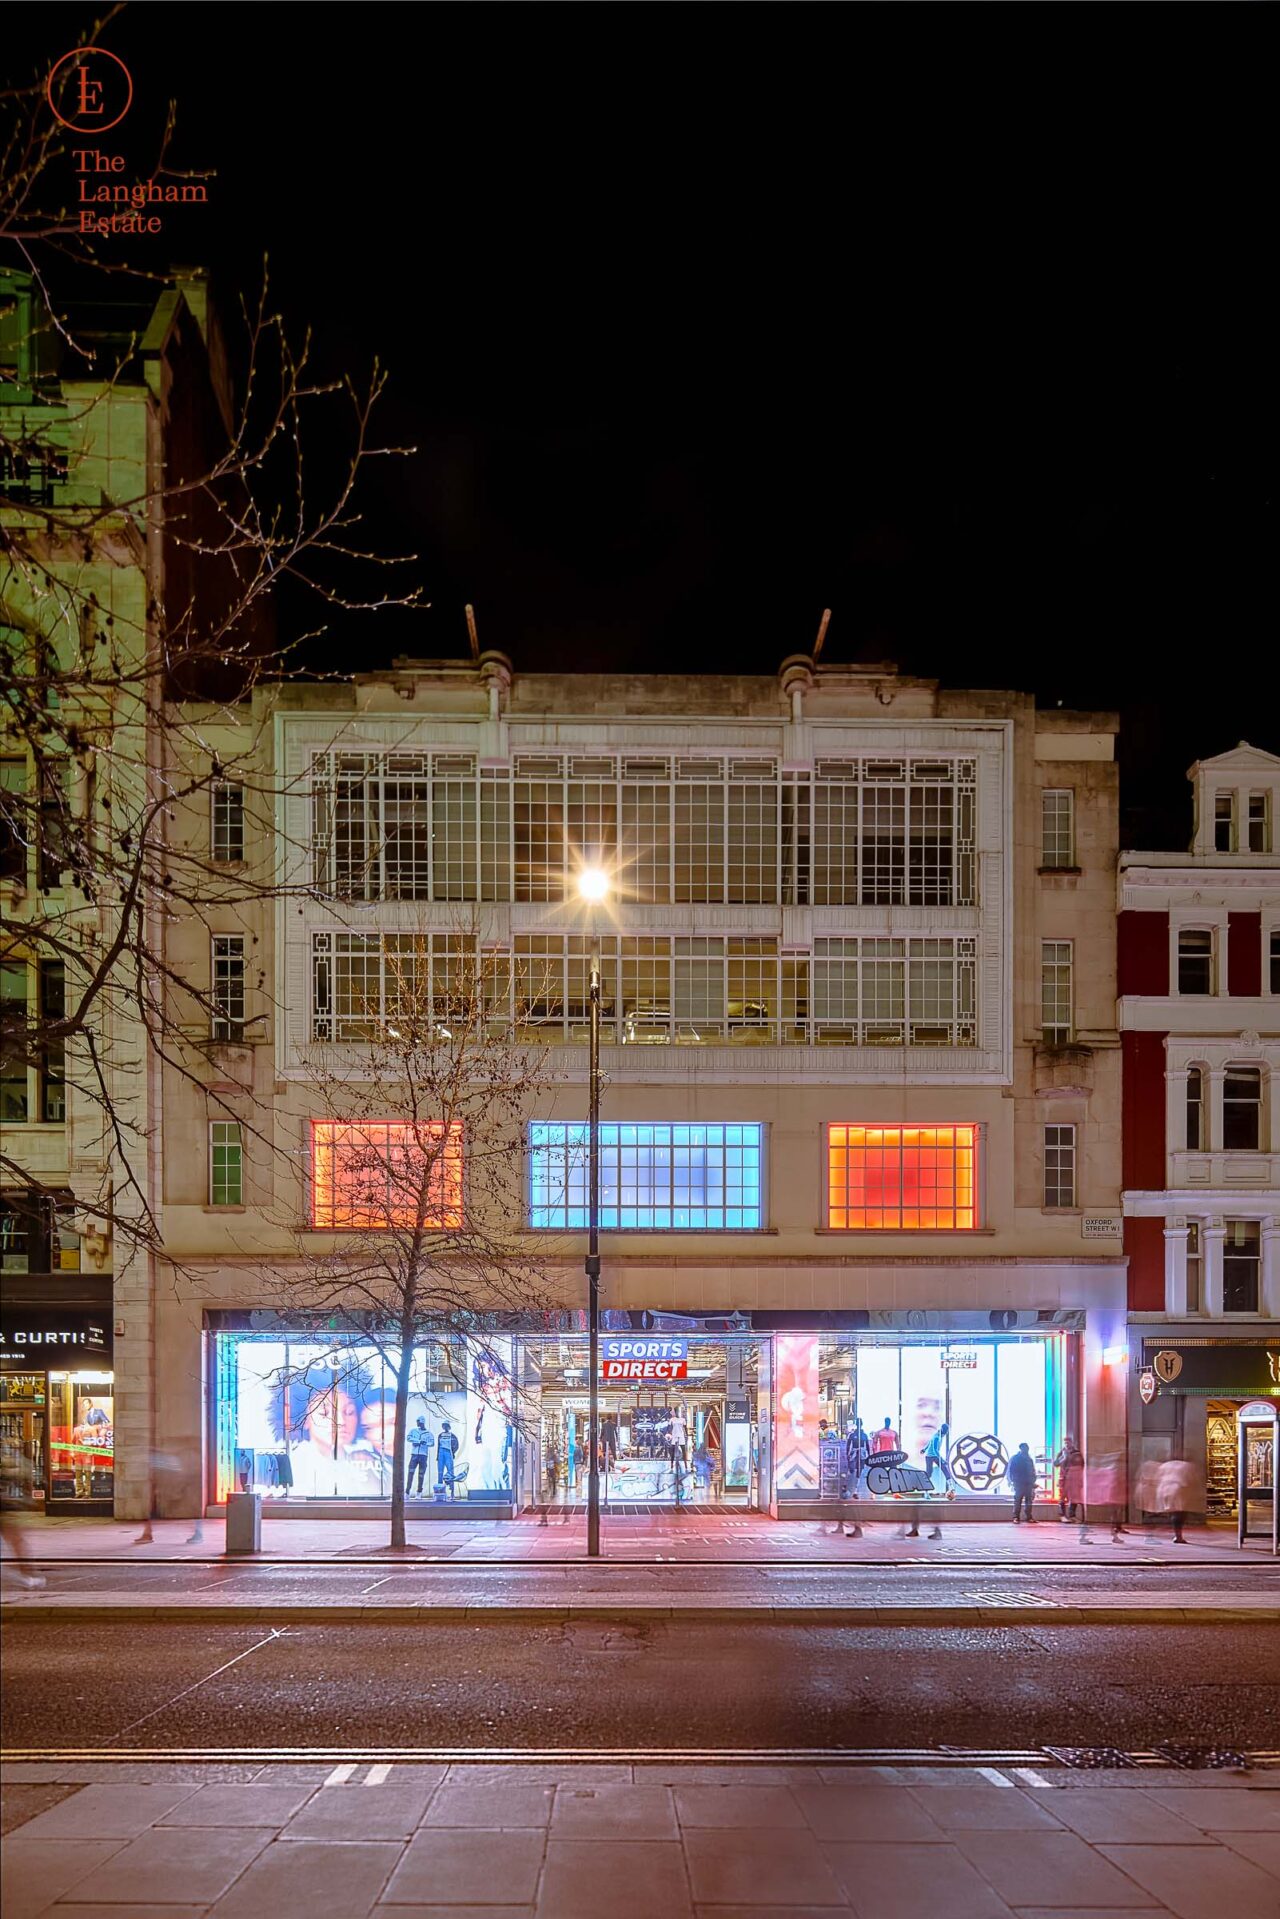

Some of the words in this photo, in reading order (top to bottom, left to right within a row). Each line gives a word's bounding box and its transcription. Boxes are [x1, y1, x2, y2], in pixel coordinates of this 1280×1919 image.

[607, 1342, 683, 1358] SPORTS
[943, 1352, 975, 1360] SPORTS
[607, 1362, 683, 1377] DIRECT
[868, 1455, 894, 1464] MATCH
[893, 1453, 905, 1462] MY
[867, 1466, 935, 1495] GAME
